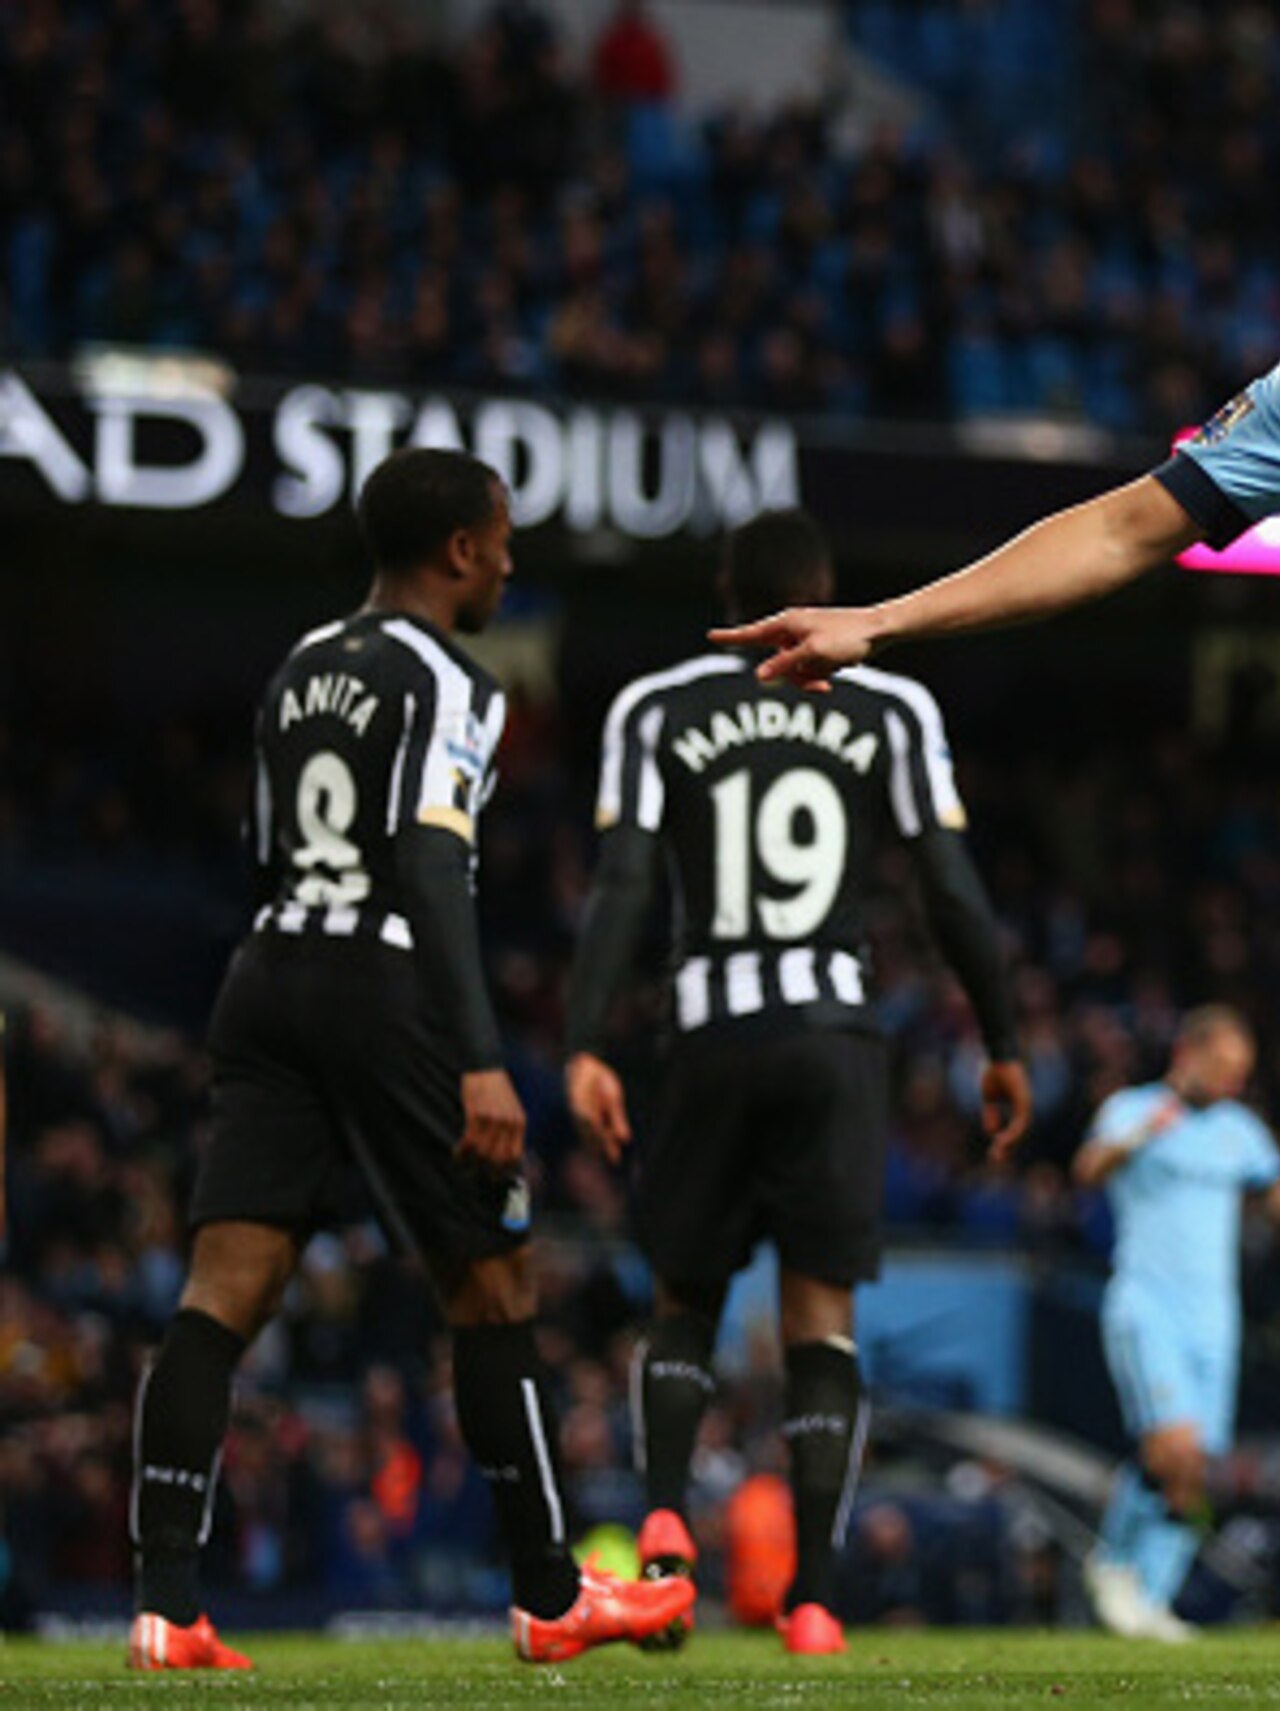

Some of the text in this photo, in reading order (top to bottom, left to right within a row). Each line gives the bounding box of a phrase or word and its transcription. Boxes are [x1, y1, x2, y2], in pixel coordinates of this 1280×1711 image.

[279, 674, 380, 737] ANITA
[673, 700, 878, 775] HAIDARA
[292, 751, 370, 906] 8
[710, 767, 846, 940] 19
